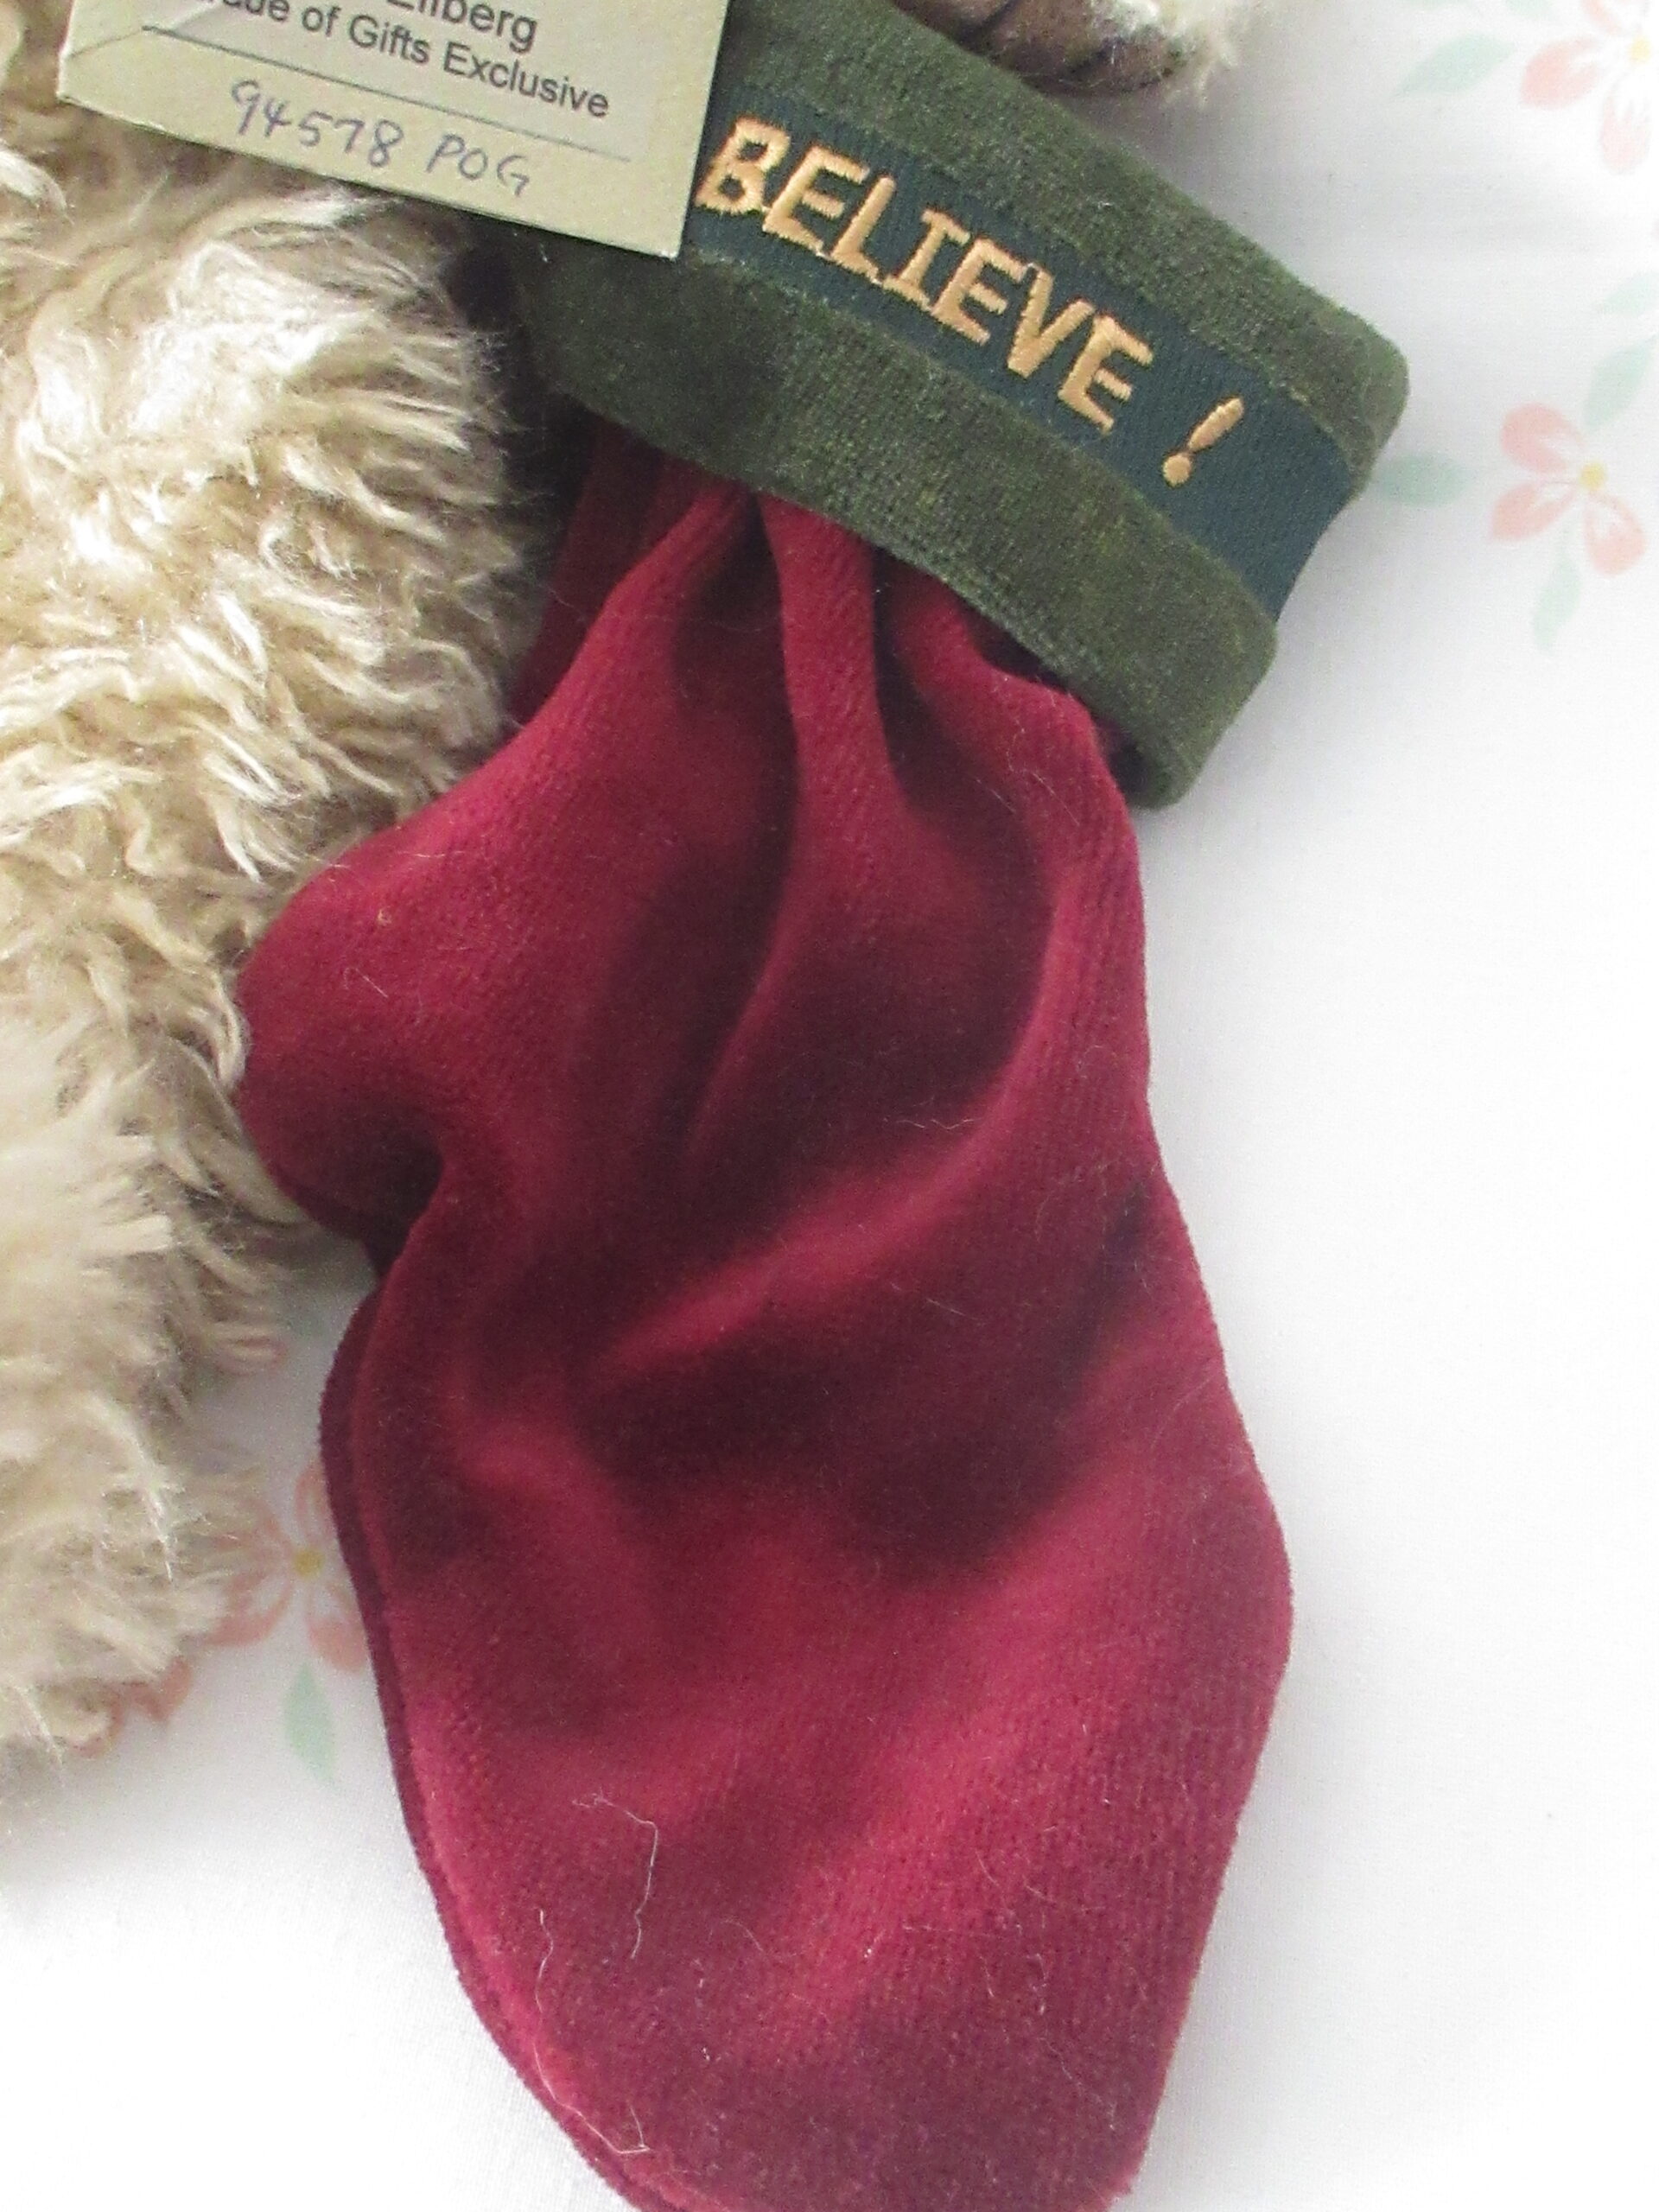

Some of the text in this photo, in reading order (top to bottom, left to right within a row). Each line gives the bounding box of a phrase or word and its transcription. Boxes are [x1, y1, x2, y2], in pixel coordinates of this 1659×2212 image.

[302, 6, 342, 37] of
[349, 15, 430, 65] Gifts
[442, 41, 609, 118] Exclusive
[386, 0, 537, 53] berg
[231, 79, 531, 198] 94578 POG
[695, 114, 1244, 487] BELIEVE !
